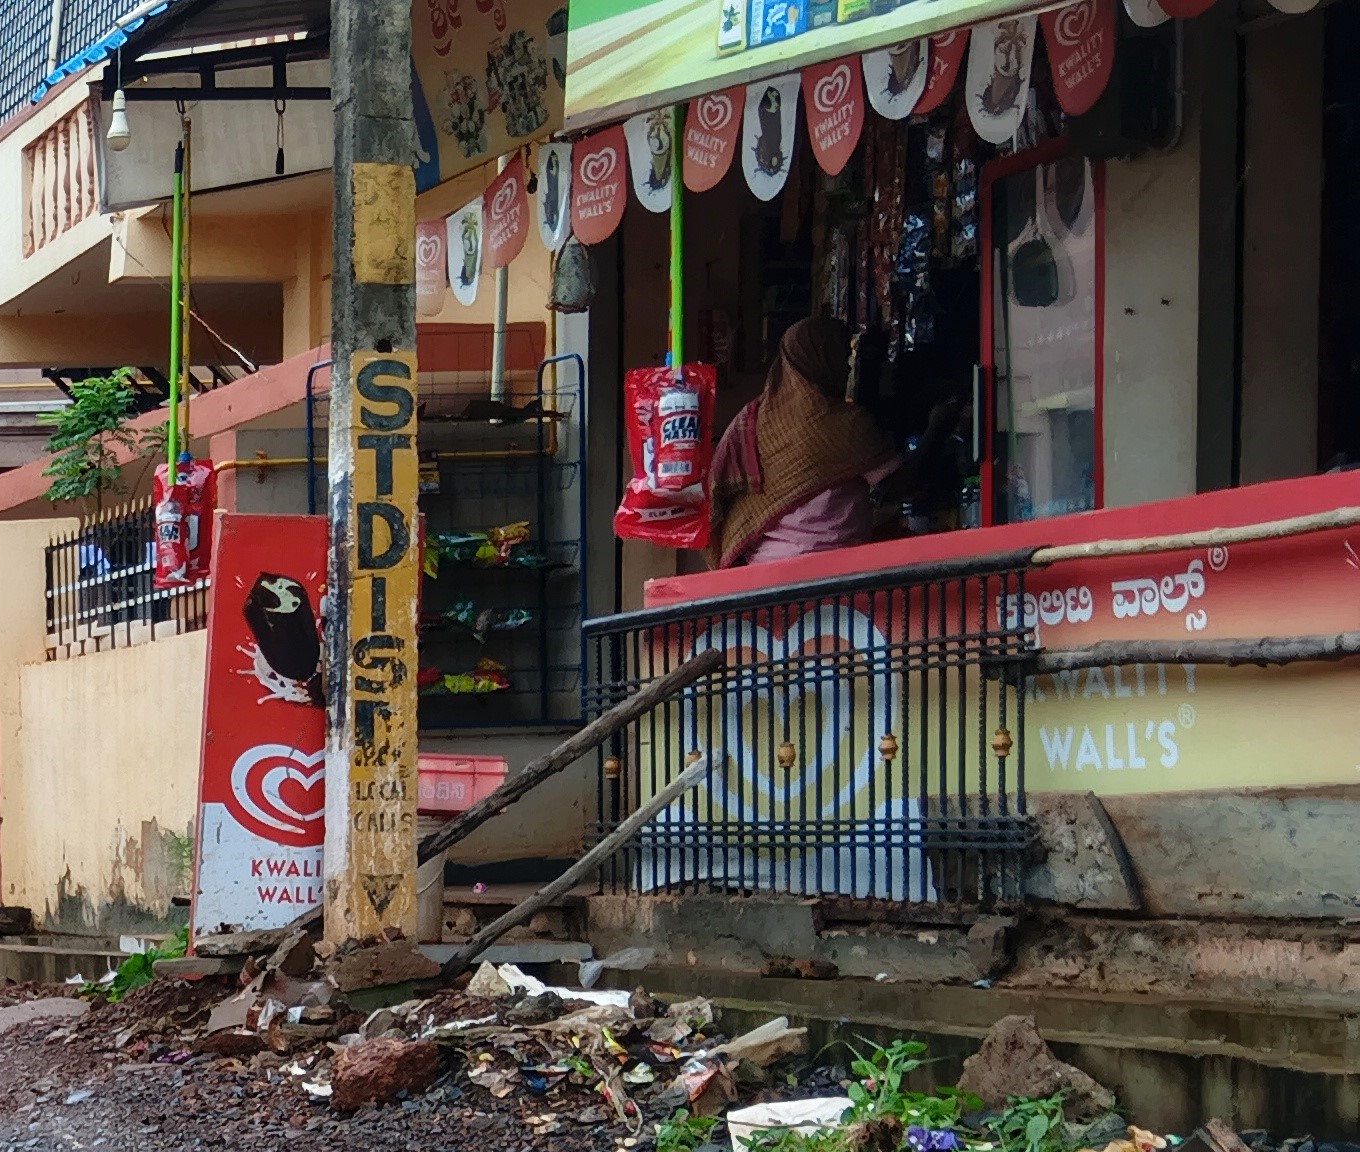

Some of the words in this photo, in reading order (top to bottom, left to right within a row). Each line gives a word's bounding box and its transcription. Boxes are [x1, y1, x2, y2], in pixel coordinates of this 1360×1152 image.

[1040, 719, 1180, 772] WALL'S
[251, 858, 321, 877] KWALI
[257, 885, 323, 904] WALL'
